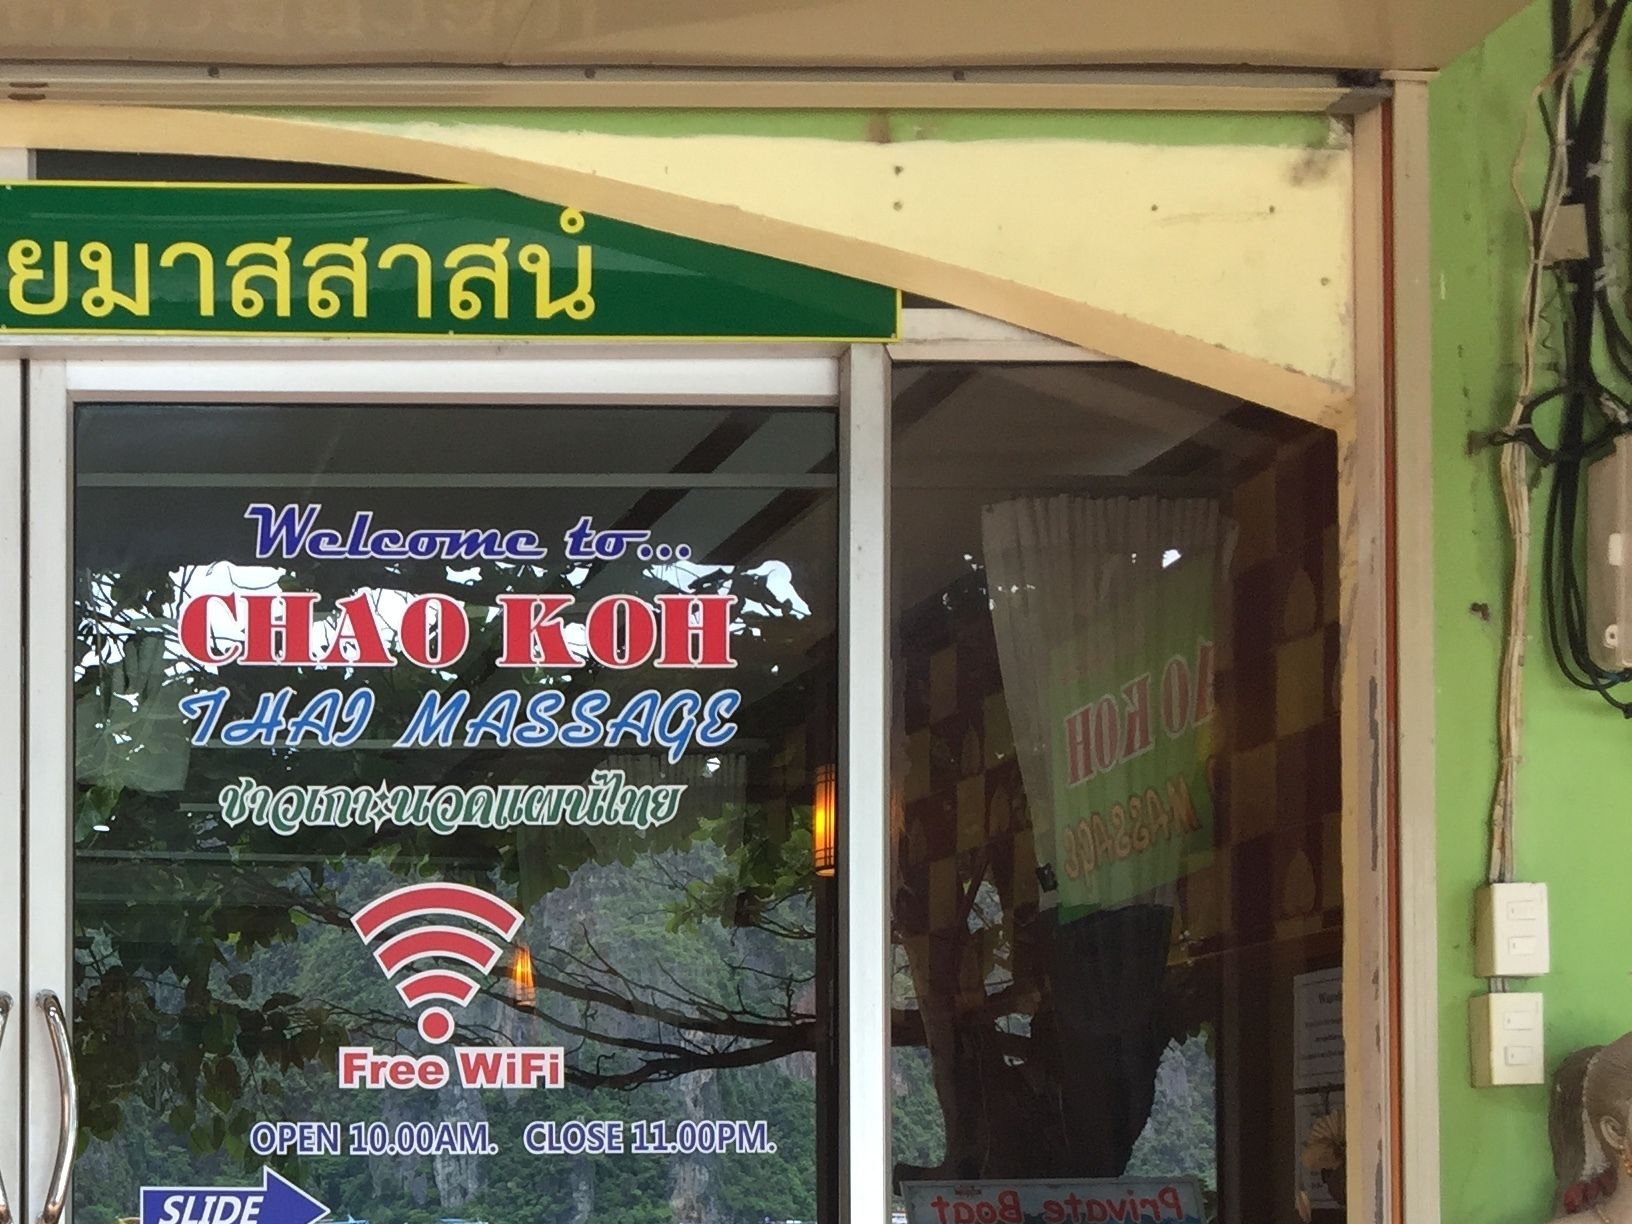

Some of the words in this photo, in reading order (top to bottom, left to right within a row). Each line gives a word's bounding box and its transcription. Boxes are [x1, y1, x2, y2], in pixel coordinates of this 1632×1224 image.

[244, 502, 548, 561] Welcome
[177, 589, 470, 670] CHAO
[494, 592, 740, 670] KOH
[180, 688, 377, 748] THAI
[391, 688, 743, 759] MASSAGE
[339, 1047, 449, 1089] Free
[454, 1046, 566, 1089] WiFi
[249, 1121, 343, 1156] OPEN
[348, 1121, 499, 1155] 10.00AM.
[523, 1120, 624, 1155] CLOSE
[630, 1119, 778, 1155] 11.00PM.
